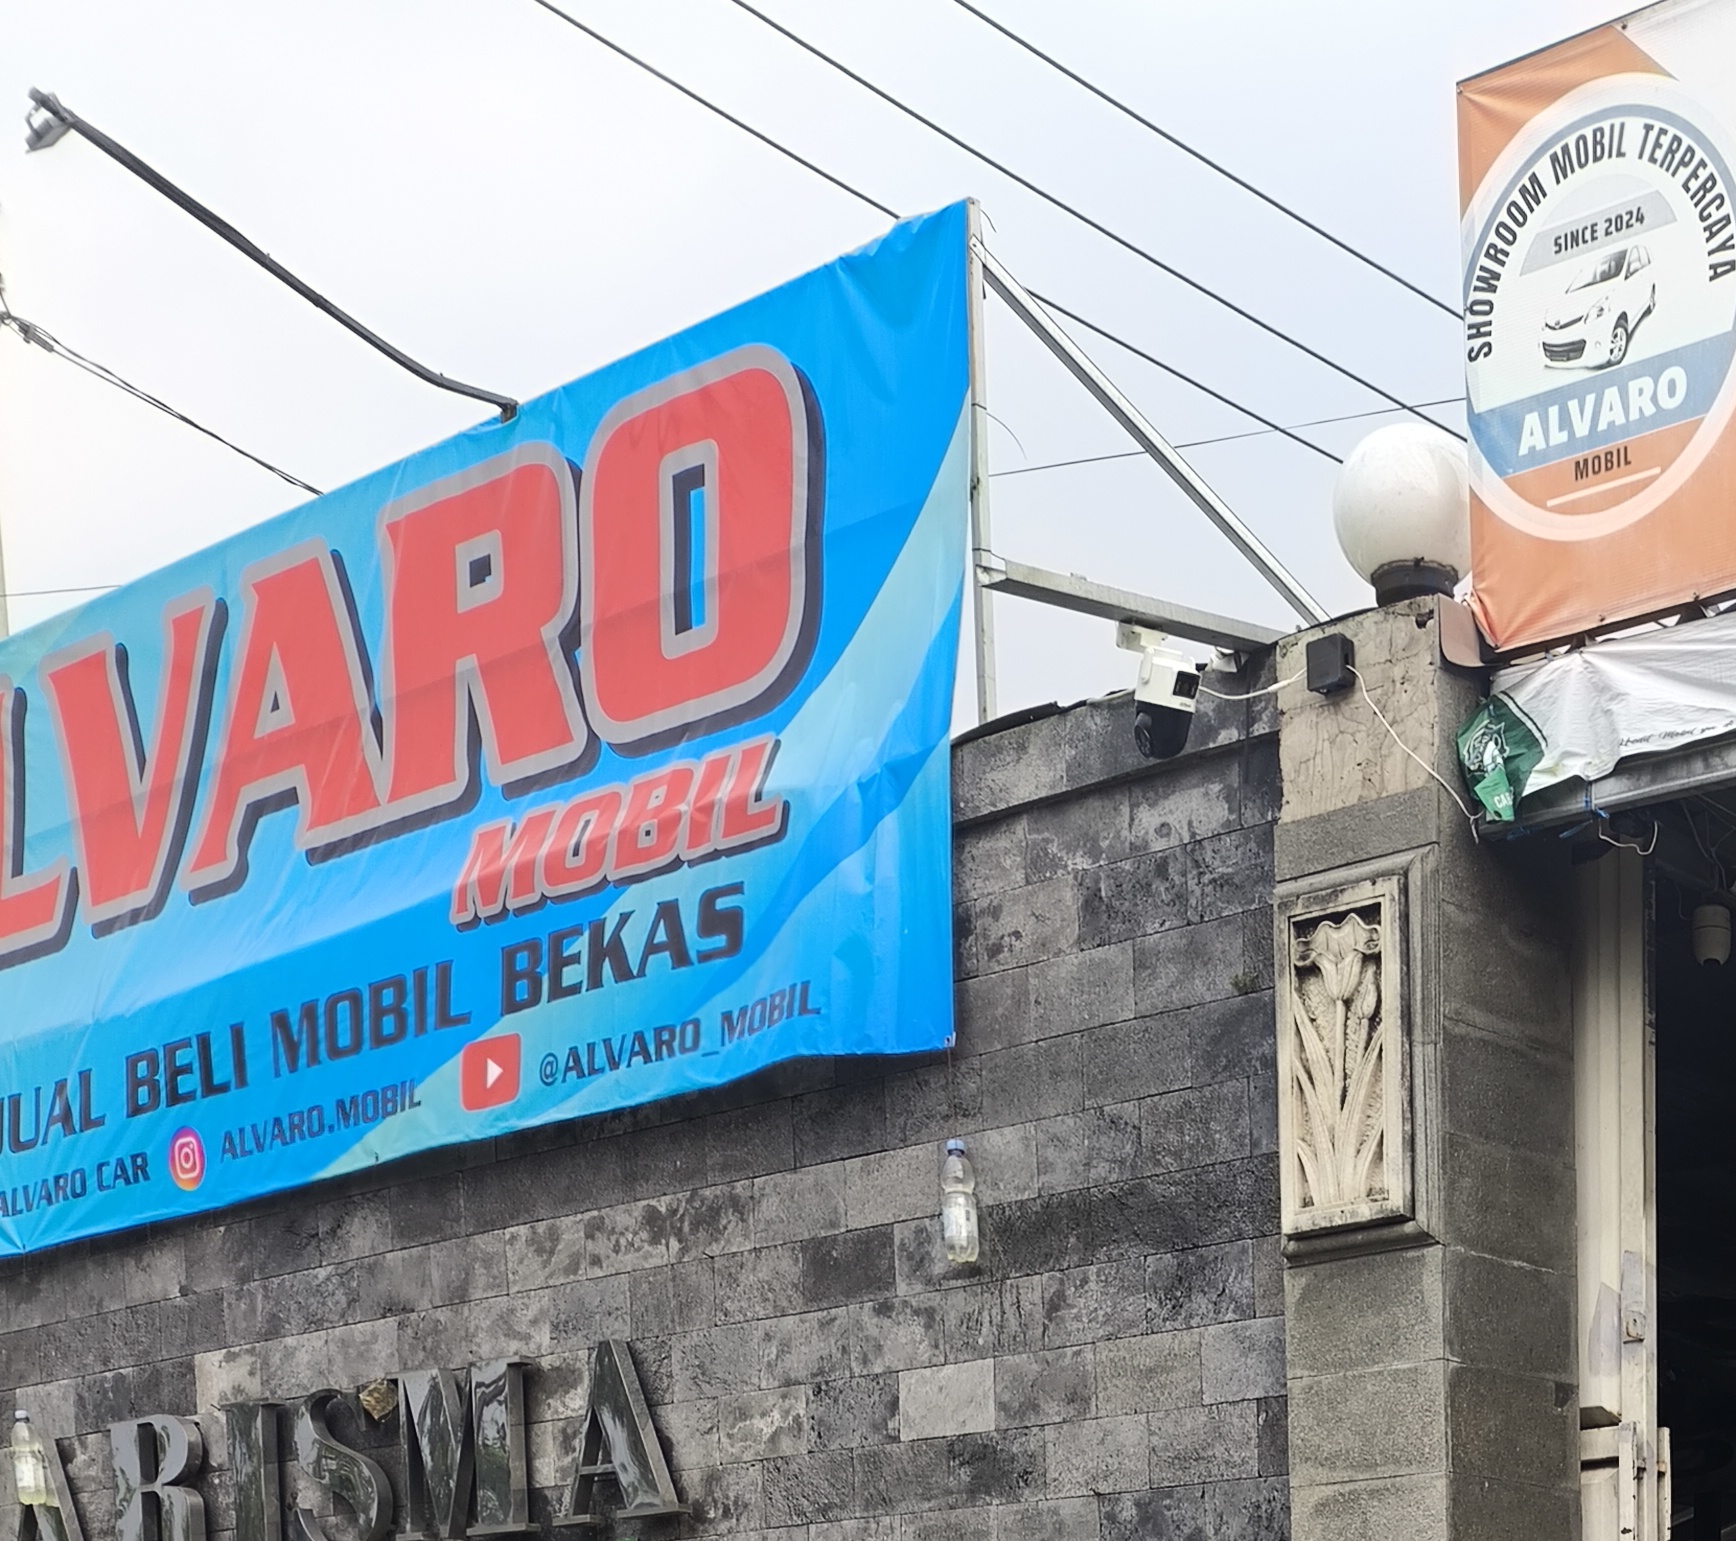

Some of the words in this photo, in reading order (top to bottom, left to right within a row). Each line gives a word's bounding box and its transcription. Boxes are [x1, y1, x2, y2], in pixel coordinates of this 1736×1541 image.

[1468, 171, 1548, 363] SHOWROOM
[1549, 121, 1626, 186] MOBIL
[1637, 122, 1736, 283] TERPERCAYA
[1553, 222, 1599, 255] SINCE
[1604, 206, 1646, 238] 2024
[1518, 365, 1688, 457] ALVARO
[1574, 446, 1632, 482] MOBIL
[449, 732, 792, 934] MOBIL
[0, 1068, 105, 1155] UAL
[125, 1021, 249, 1119] BELI
[270, 958, 472, 1079] MOBIL
[501, 880, 745, 1017] BEKAS
[539, 979, 822, 1087] @ALVARO_MOBIL
[219, 1077, 421, 1164] ALVARO.MOBIL
[96, 1151, 151, 1193] CAR
